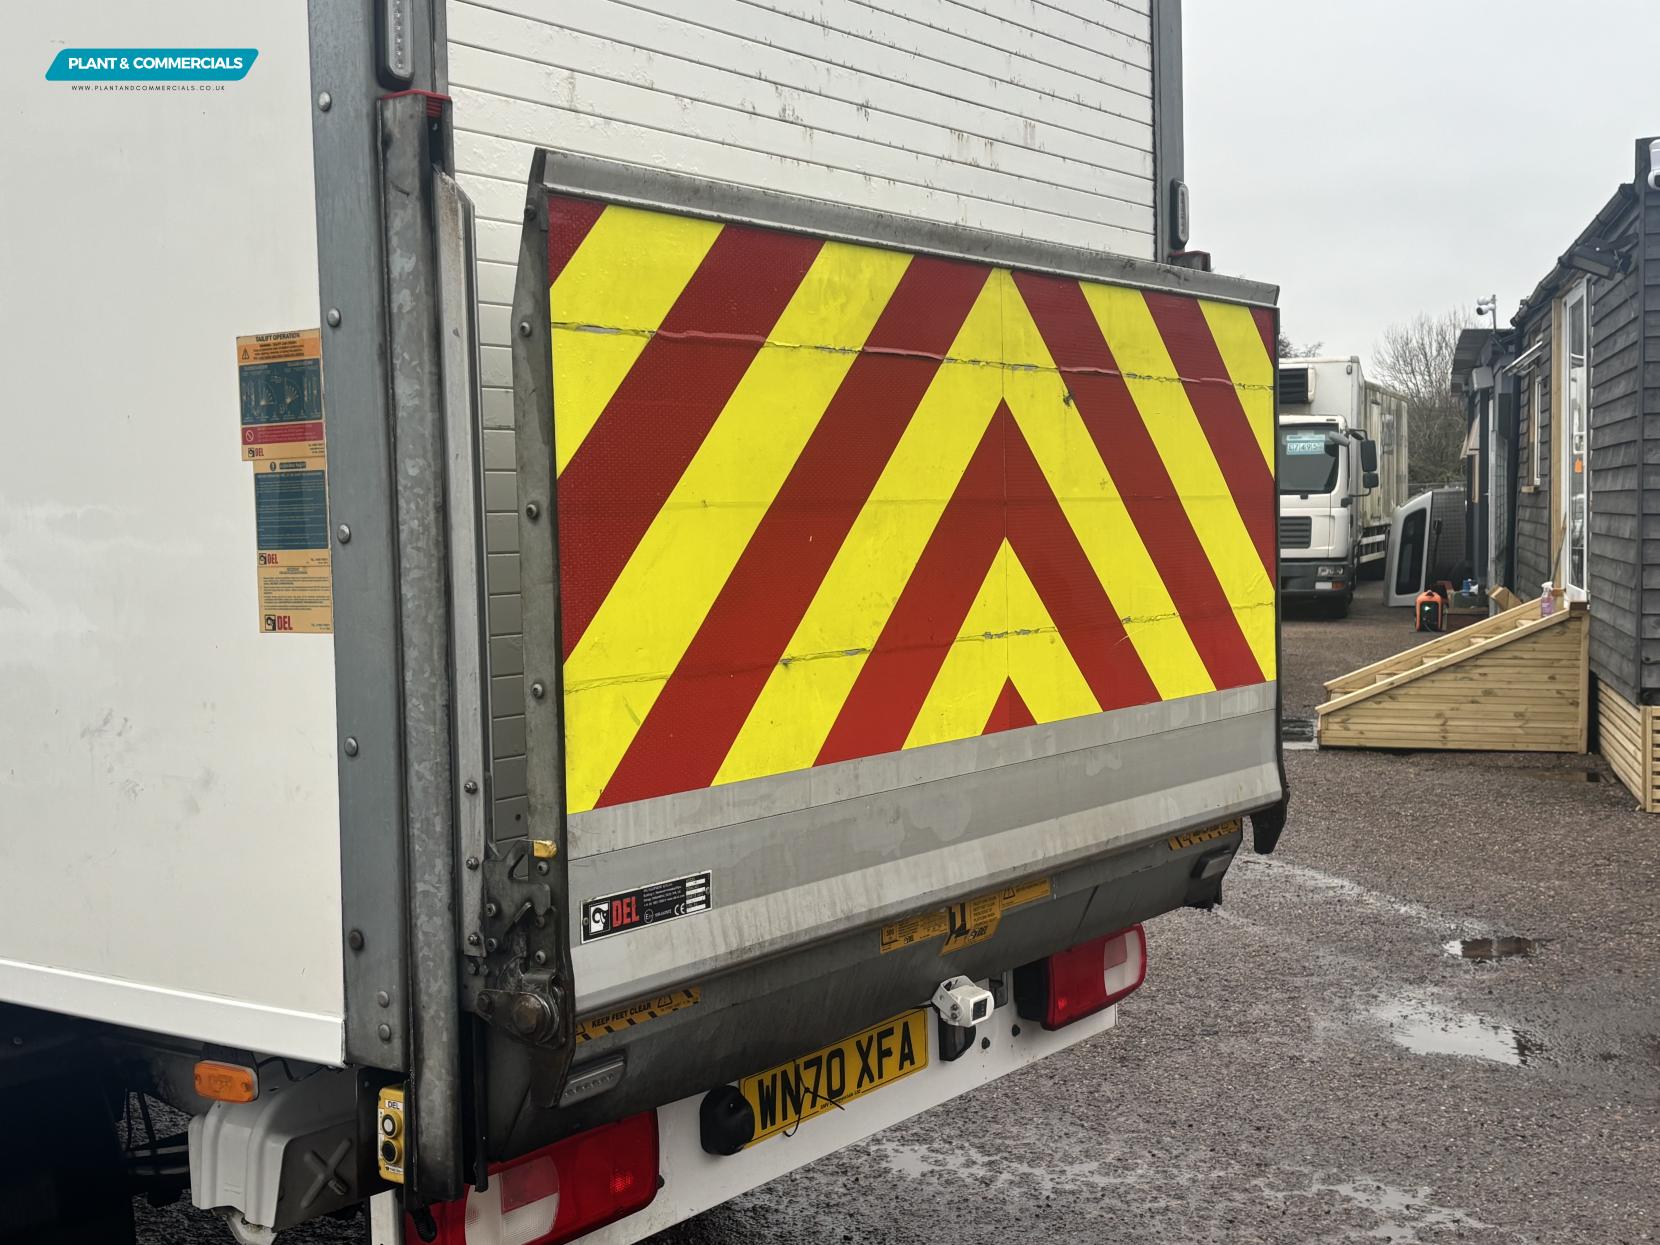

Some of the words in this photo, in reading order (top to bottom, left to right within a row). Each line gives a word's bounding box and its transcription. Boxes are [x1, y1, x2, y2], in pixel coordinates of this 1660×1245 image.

[254, 447, 265, 457] DEL
[267, 553, 279, 565] DEL
[276, 615, 293, 631] DEL
[612, 896, 640, 928] DEL
[591, 1015, 610, 1028] KEEP
[611, 1009, 629, 1022] FEET
[629, 1002, 652, 1015] CLEAR
[757, 1046, 846, 1131] WN70
[855, 1020, 916, 1090] XFA
[388, 1101, 399, 1110] DEL
